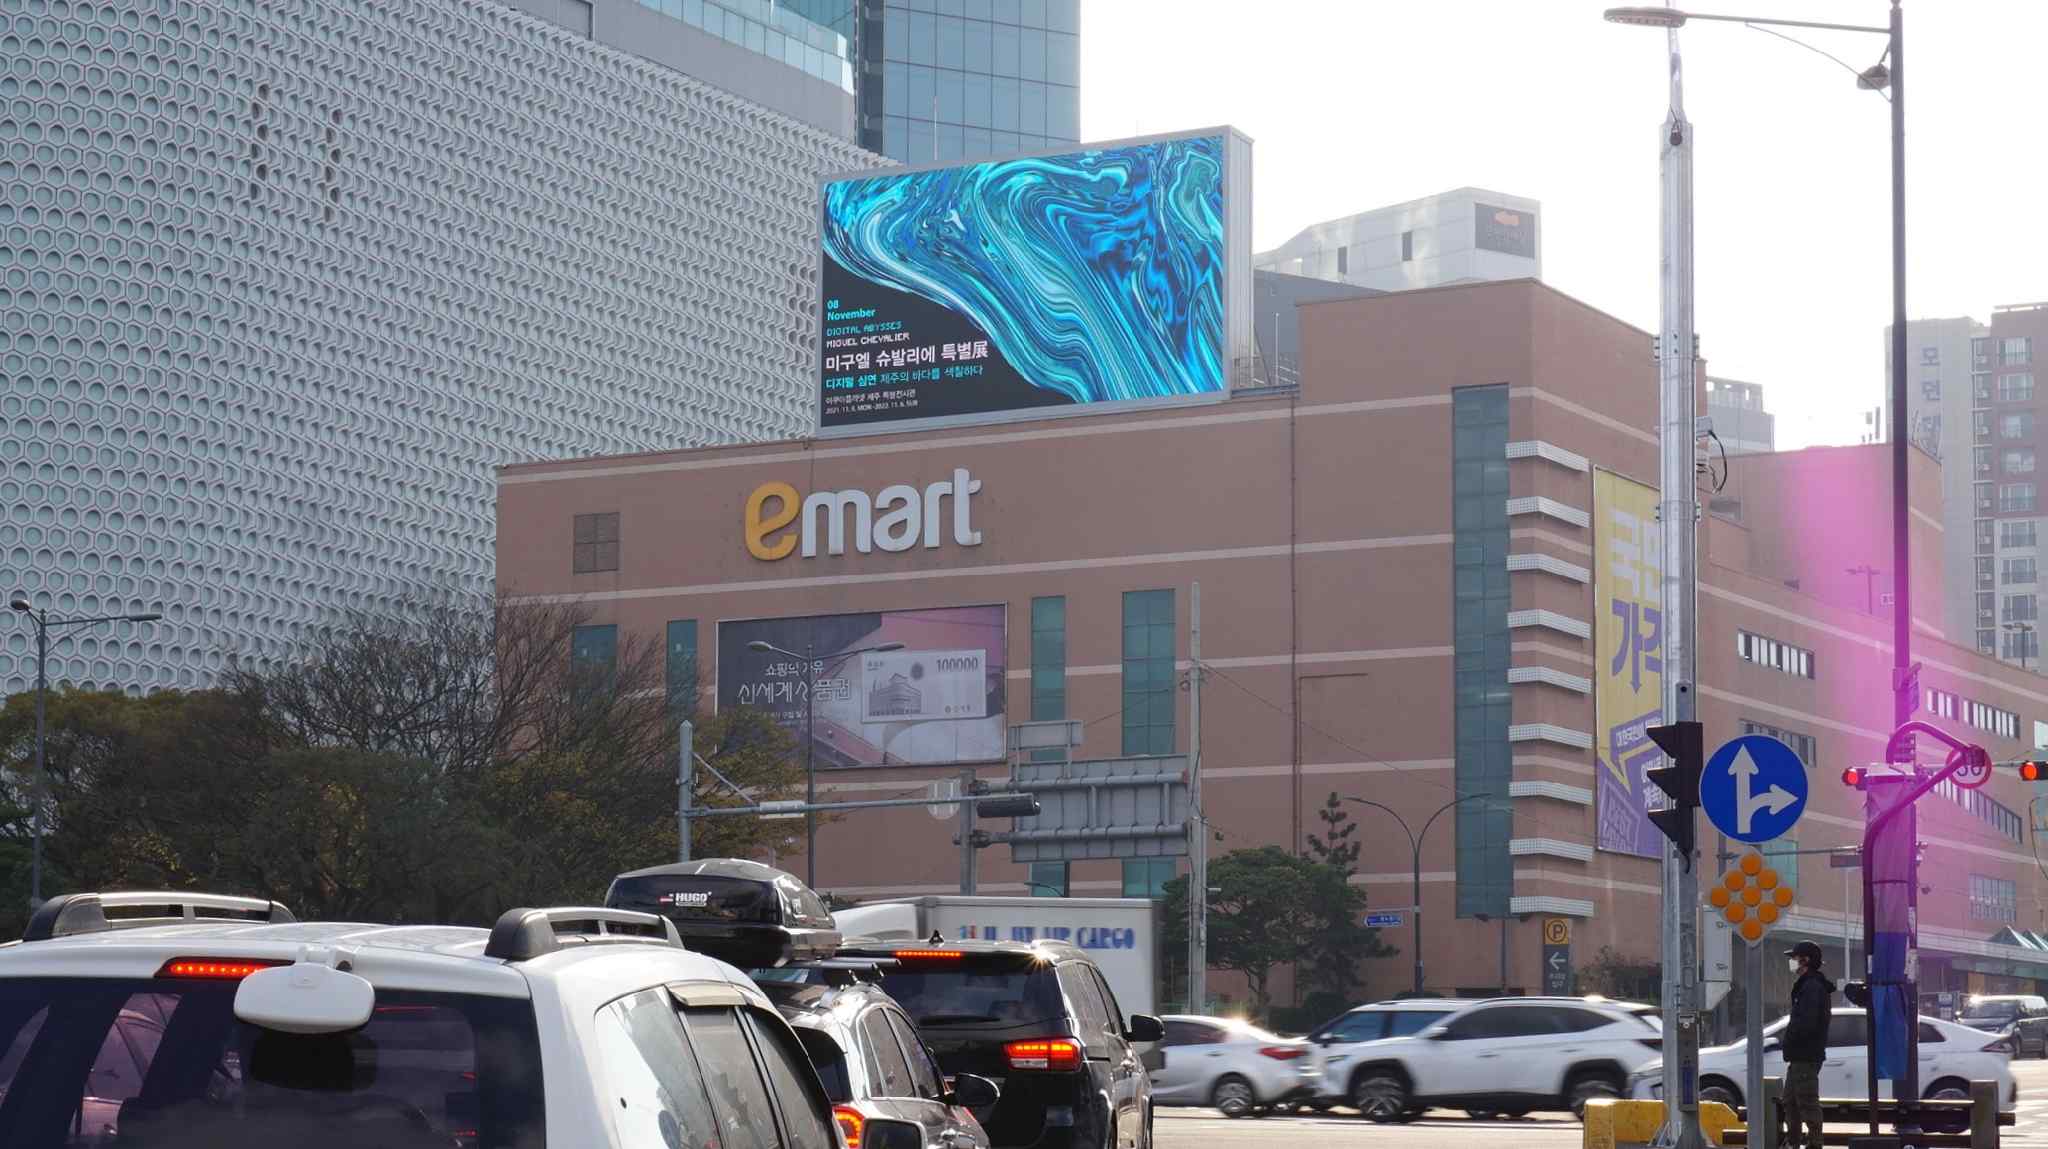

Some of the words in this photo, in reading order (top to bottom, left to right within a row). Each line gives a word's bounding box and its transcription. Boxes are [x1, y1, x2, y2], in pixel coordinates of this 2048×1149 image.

[827, 299, 839, 310] 08
[827, 308, 876, 321] November
[826, 325, 861, 337] DIGITAL
[826, 337, 858, 348] MIGUEL
[860, 332, 910, 345] CHEVALIER
[826, 351, 870, 372] 미구엘
[876, 345, 936, 367] 슈발리에
[941, 340, 988, 362] 특별展
[826, 376, 854, 390] 디지털
[858, 374, 877, 388] 심연
[912, 367, 940, 382] 바다를
[745, 467, 982, 561] emart
[765, 662, 800, 677] 쇼핑의
[675, 892, 708, 902] HUGO
[1076, 926, 1136, 950] CARGO
